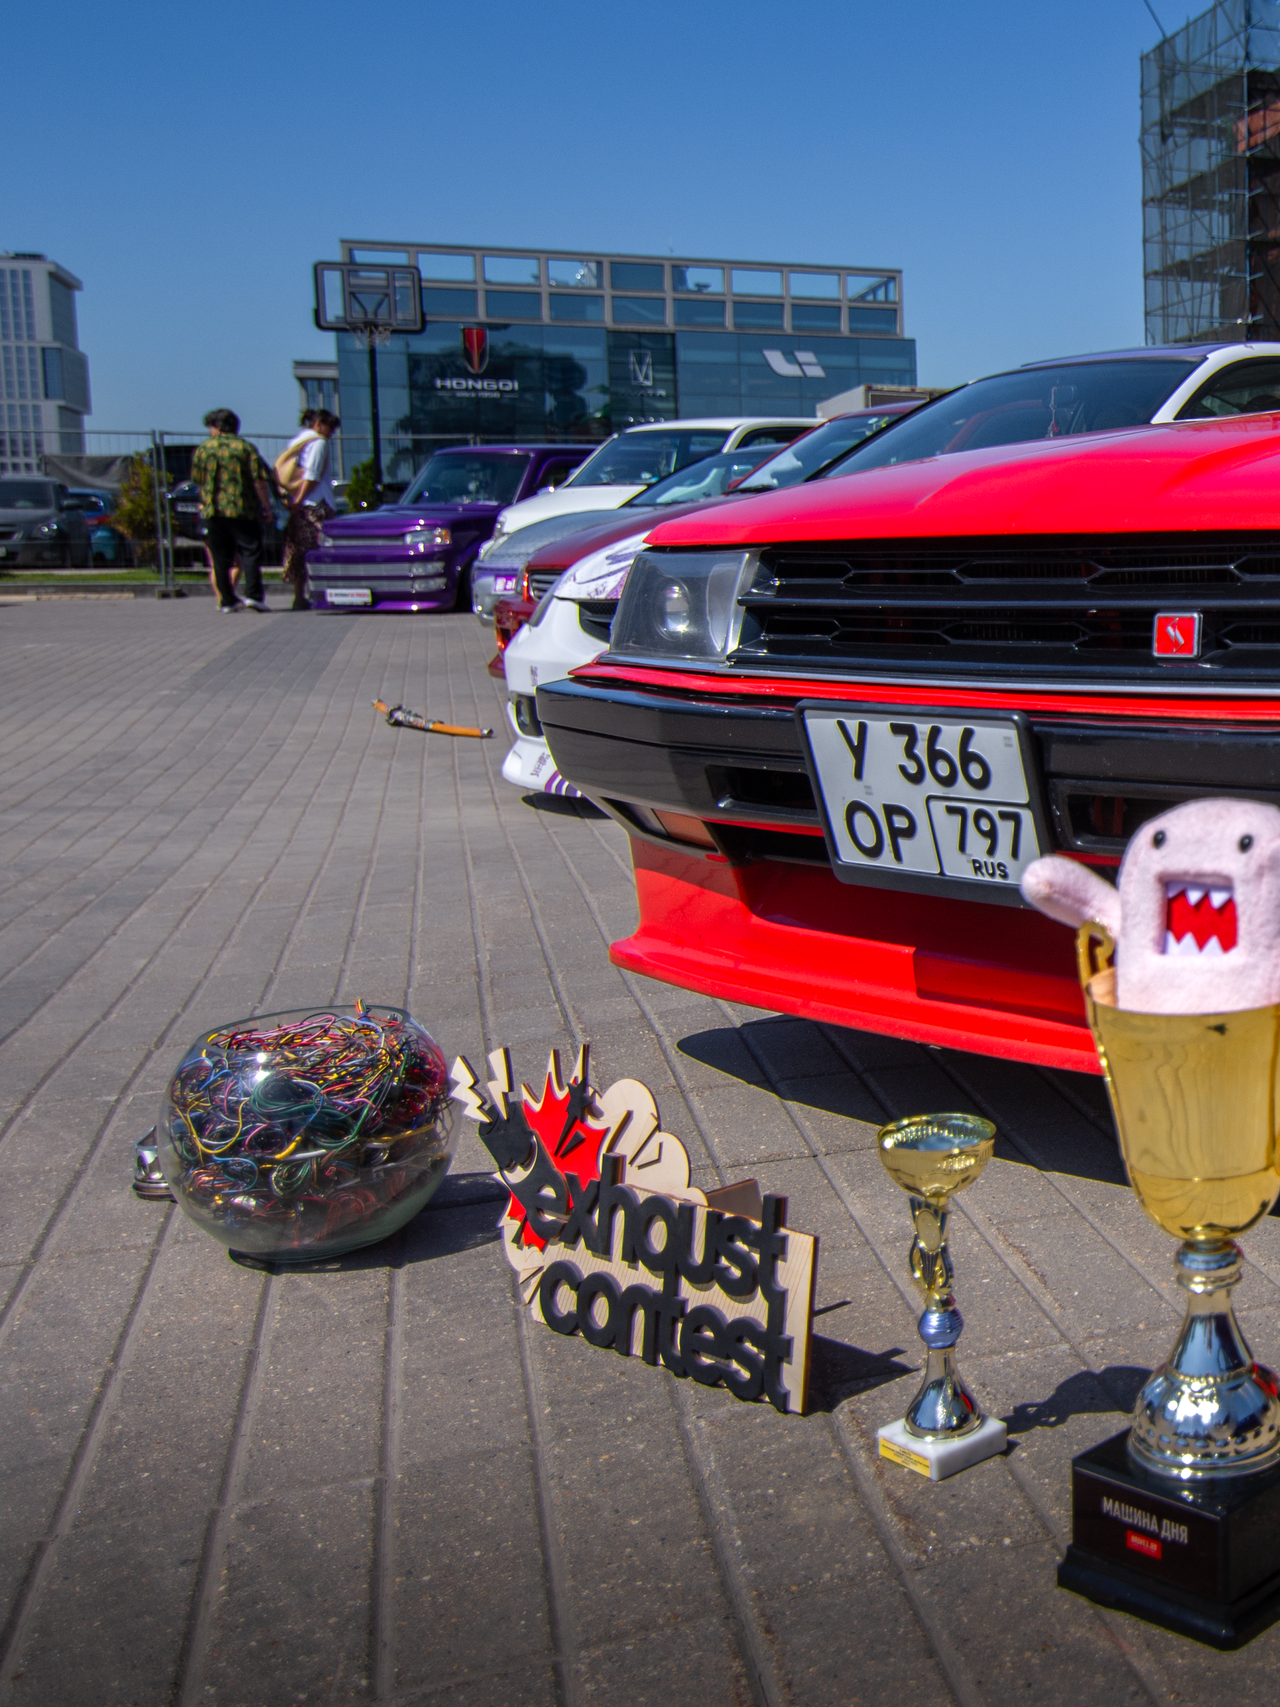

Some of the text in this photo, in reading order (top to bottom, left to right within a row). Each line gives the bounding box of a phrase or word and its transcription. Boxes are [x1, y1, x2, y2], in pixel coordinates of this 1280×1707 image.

[434, 377, 519, 391] HONGQI
[889, 722, 992, 790] 366
[844, 799, 1022, 864] ОР 797
[971, 858, 1009, 879] RUS
[539, 1258, 794, 1413] contest
[1102, 1496, 1188, 1544] МАШИНА ДНЯ
